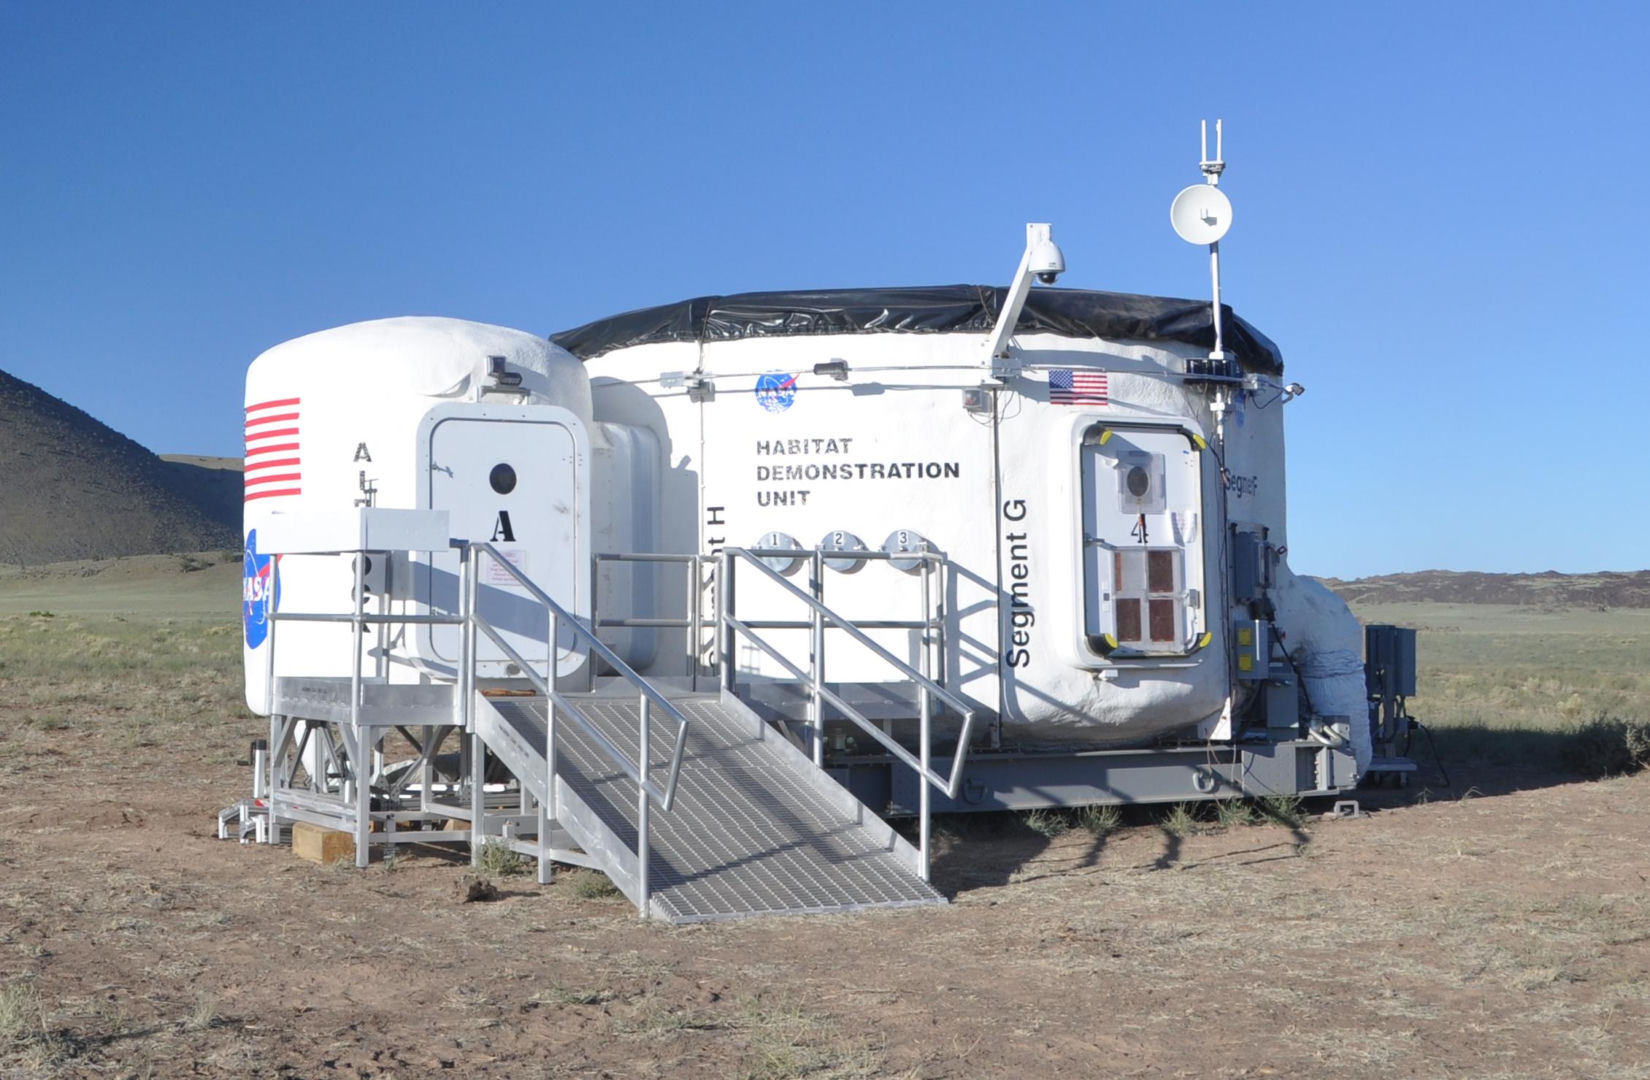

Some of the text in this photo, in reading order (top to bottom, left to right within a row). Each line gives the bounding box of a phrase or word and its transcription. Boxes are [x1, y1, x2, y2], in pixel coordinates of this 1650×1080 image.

[757, 438, 853, 456] HABITAT
[757, 462, 960, 481] DEMONSTRATION
[757, 490, 811, 507] UNIT
[707, 506, 725, 525] H
[490, 510, 517, 543] A
[772, 533, 778, 546] 1
[835, 532, 843, 545] 2
[899, 531, 908, 544] 3
[1003, 499, 1035, 668] Segment G
